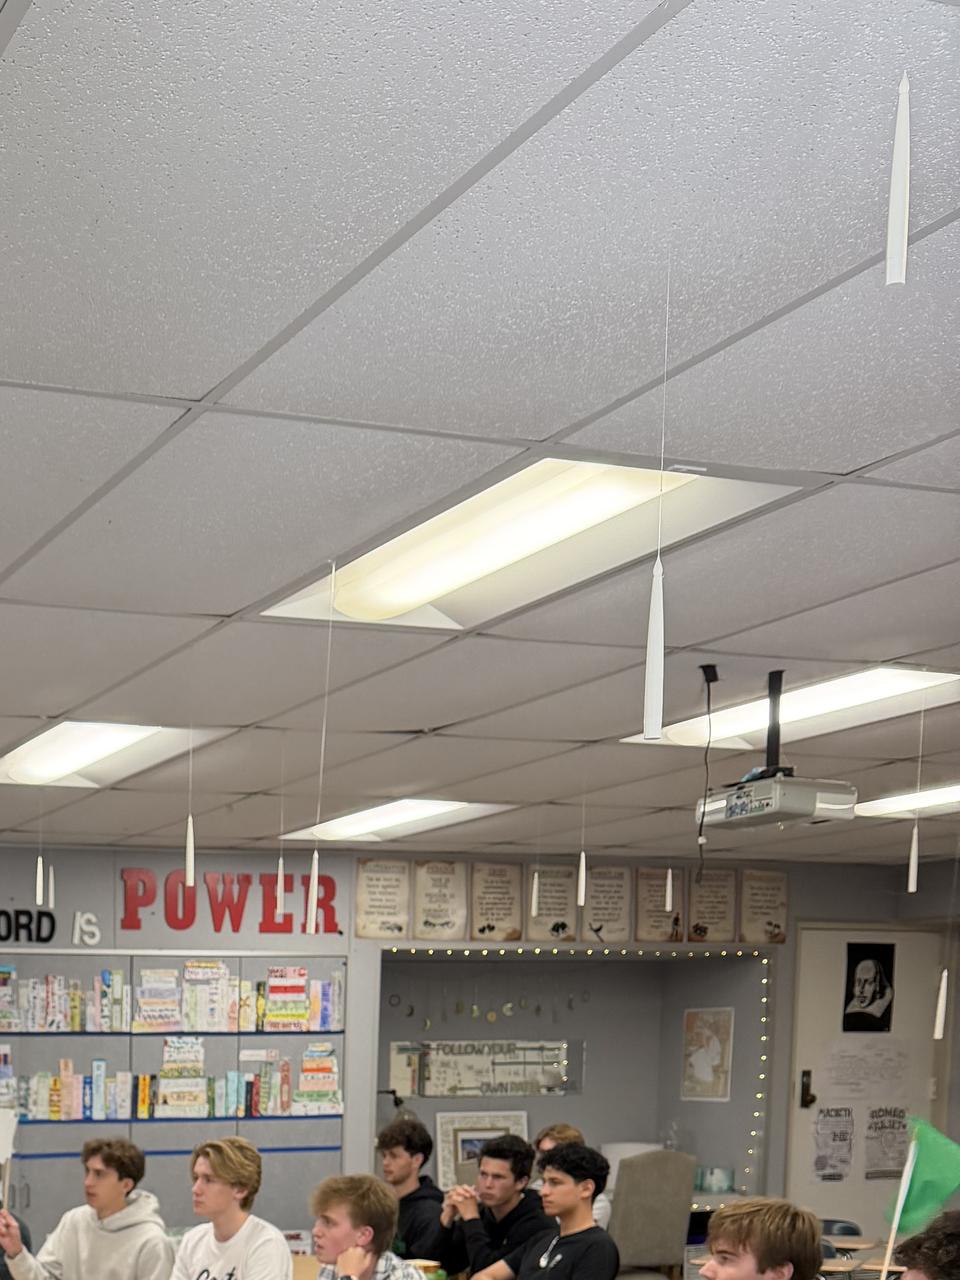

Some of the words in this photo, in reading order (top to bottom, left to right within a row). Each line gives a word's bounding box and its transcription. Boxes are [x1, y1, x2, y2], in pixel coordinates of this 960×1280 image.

[120, 867, 339, 934] POWER
[72, 911, 101, 945] IS
[436, 1043, 484, 1056] FOLLOW
[486, 1043, 517, 1056] YOUR
[480, 1081, 509, 1094] OWN
[868, 1107, 906, 1120] ROMEO
